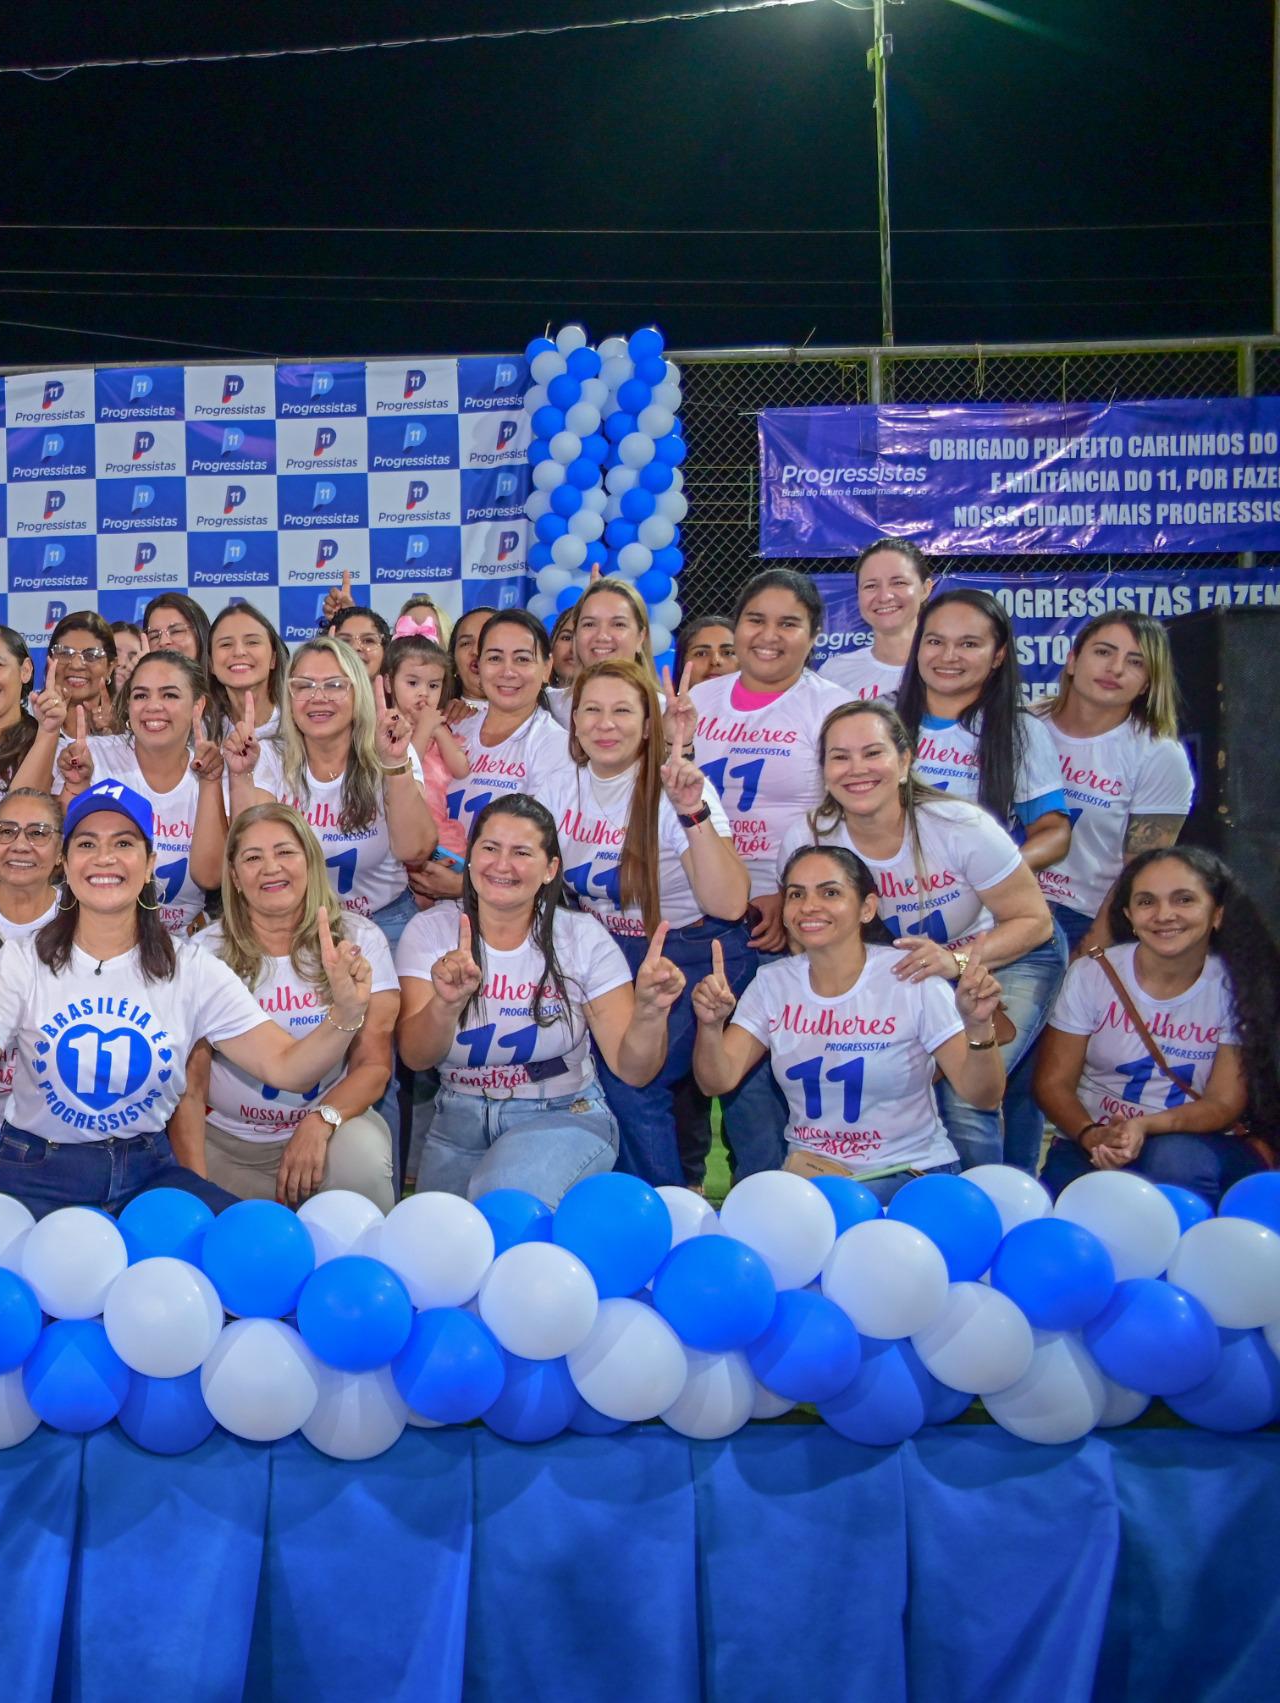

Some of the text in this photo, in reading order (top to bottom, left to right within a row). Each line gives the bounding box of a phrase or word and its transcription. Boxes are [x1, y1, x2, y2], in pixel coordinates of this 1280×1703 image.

[281, 402, 357, 415] Progressistas
[376, 399, 449, 411] Progressistas
[464, 394, 523, 409] Progressis
[15, 409, 86, 422] Progressistas
[100, 405, 175, 419] Progressistas
[194, 404, 266, 417] Progressistas
[929, 432, 1277, 461] OBRIGADO PREFEITO CARLINHOS DO
[285, 457, 358, 470] Progressistas
[373, 454, 450, 468] Progressistas
[469, 449, 527, 464] Progressist
[12, 463, 87, 478] Progressistas
[105, 461, 176, 473] Progressistas
[191, 459, 267, 472] Progressistas
[781, 464, 927, 486] Progressistas
[991, 466, 1280, 494] E MILITÂNCIA DO 11, POR FAZE
[782, 488, 804, 497] Brasil
[806, 488, 818, 497] do
[852, 487, 876, 496] Brasil
[378, 510, 451, 523] Progressistas
[466, 504, 525, 519] Progressis
[954, 504, 1019, 529] NOSSA
[1023, 503, 1096, 527] CIDADE
[1100, 503, 1151, 526] MAIS
[17, 520, 87, 532] Progressistas
[102, 516, 178, 529] Progressistas
[196, 515, 268, 527] Progressistas
[283, 513, 359, 526] Progressistas
[288, 568, 361, 581] Progressisas
[376, 566, 452, 579] Progressistas
[471, 560, 528, 575] Progressis
[13, 574, 88, 588] Progressistas
[106, 572, 178, 585] Progressistas
[194, 570, 269, 583] Progressistas
[983, 586, 1192, 618] OGRESSISTAS
[696, 716, 797, 744] Mulheres
[730, 747, 791, 757] PROGRESSISTAS
[1059, 755, 1123, 797] heres
[1062, 787, 1112, 809] OGRESSISTAS
[557, 809, 626, 846] Mulhe
[896, 889, 961, 913] PROGESSISTAS
[40, 997, 152, 1039] BRASILÉIA
[500, 1004, 563, 1017] PROGREISTAS
[769, 1004, 896, 1036] Mulheres
[1092, 1000, 1220, 1043] Mlhere
[150, 1030, 168, 1044] É
[456, 1023, 539, 1067] 11
[68, 1031, 131, 1095] 11
[785, 1055, 864, 1124] 11
[1115, 1055, 1196, 1109] 11
[38, 1080, 162, 1133] PROGRESSISTAS
[240, 1104, 285, 1122] NOSSA
